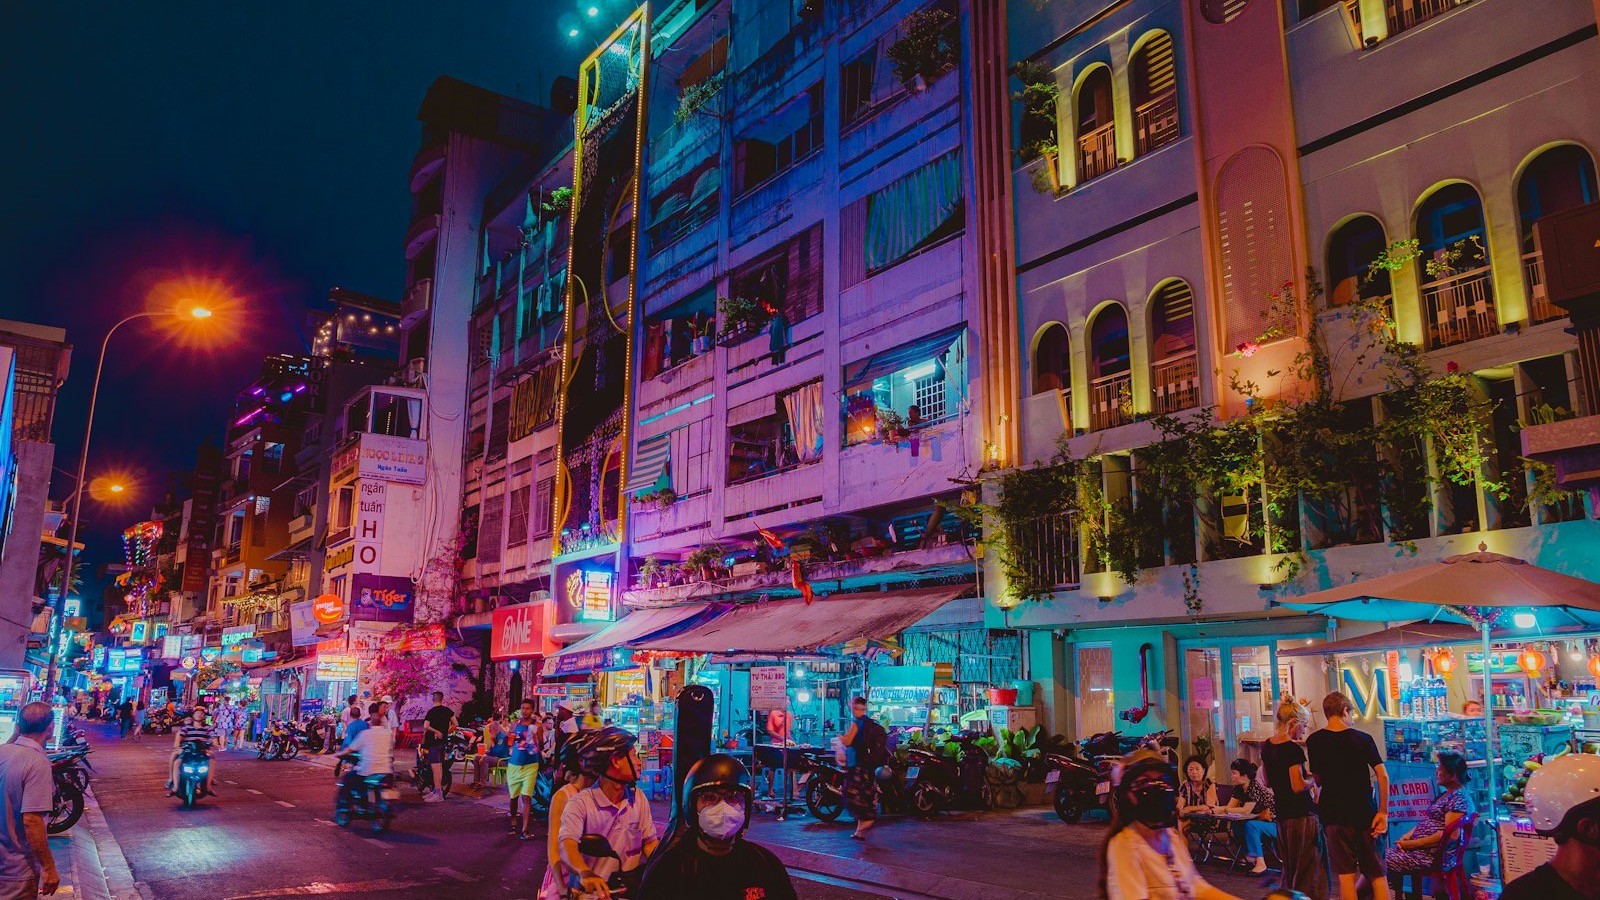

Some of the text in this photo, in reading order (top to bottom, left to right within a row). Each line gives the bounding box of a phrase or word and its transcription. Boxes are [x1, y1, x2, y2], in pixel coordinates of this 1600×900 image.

[417, 456, 425, 466] 2
[361, 482, 385, 496] ngân
[360, 500, 383, 513] tuấn
[374, 588, 407, 607] Tiger
[1389, 654, 1400, 697] VILLAGE
[1389, 782, 1429, 796] M CARD
